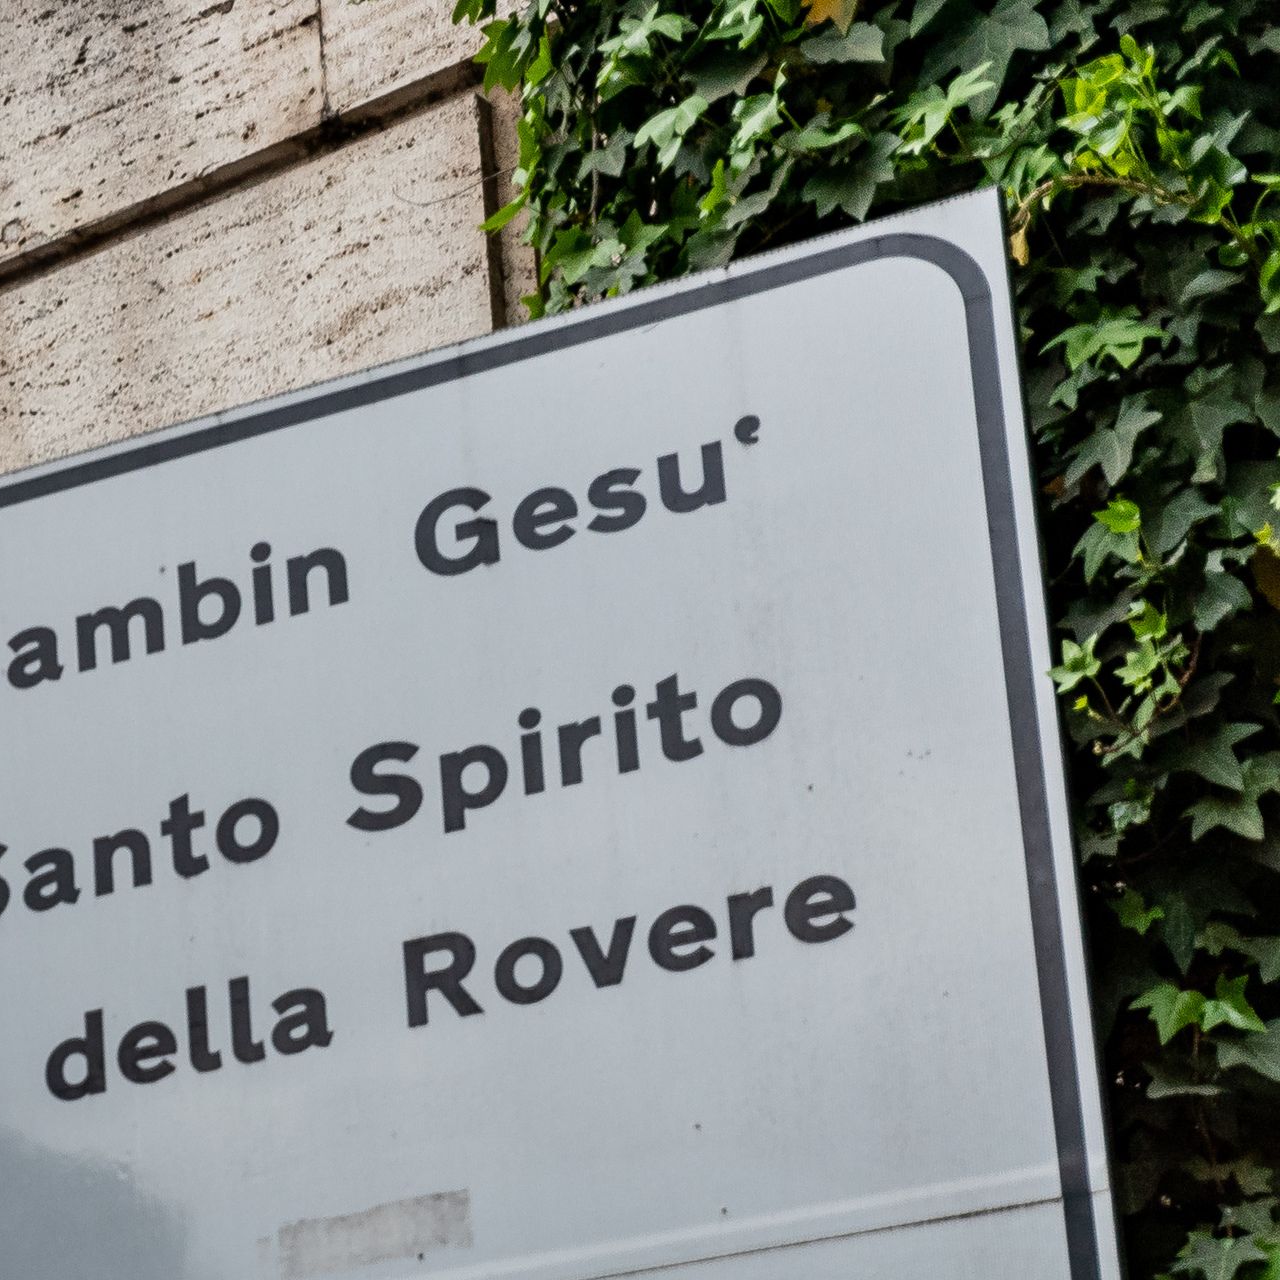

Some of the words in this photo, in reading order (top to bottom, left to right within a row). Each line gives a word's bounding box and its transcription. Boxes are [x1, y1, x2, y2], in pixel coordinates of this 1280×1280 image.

[346, 674, 783, 832] Spirito
[45, 976, 333, 1101] della
[403, 875, 856, 1028] Rovere
